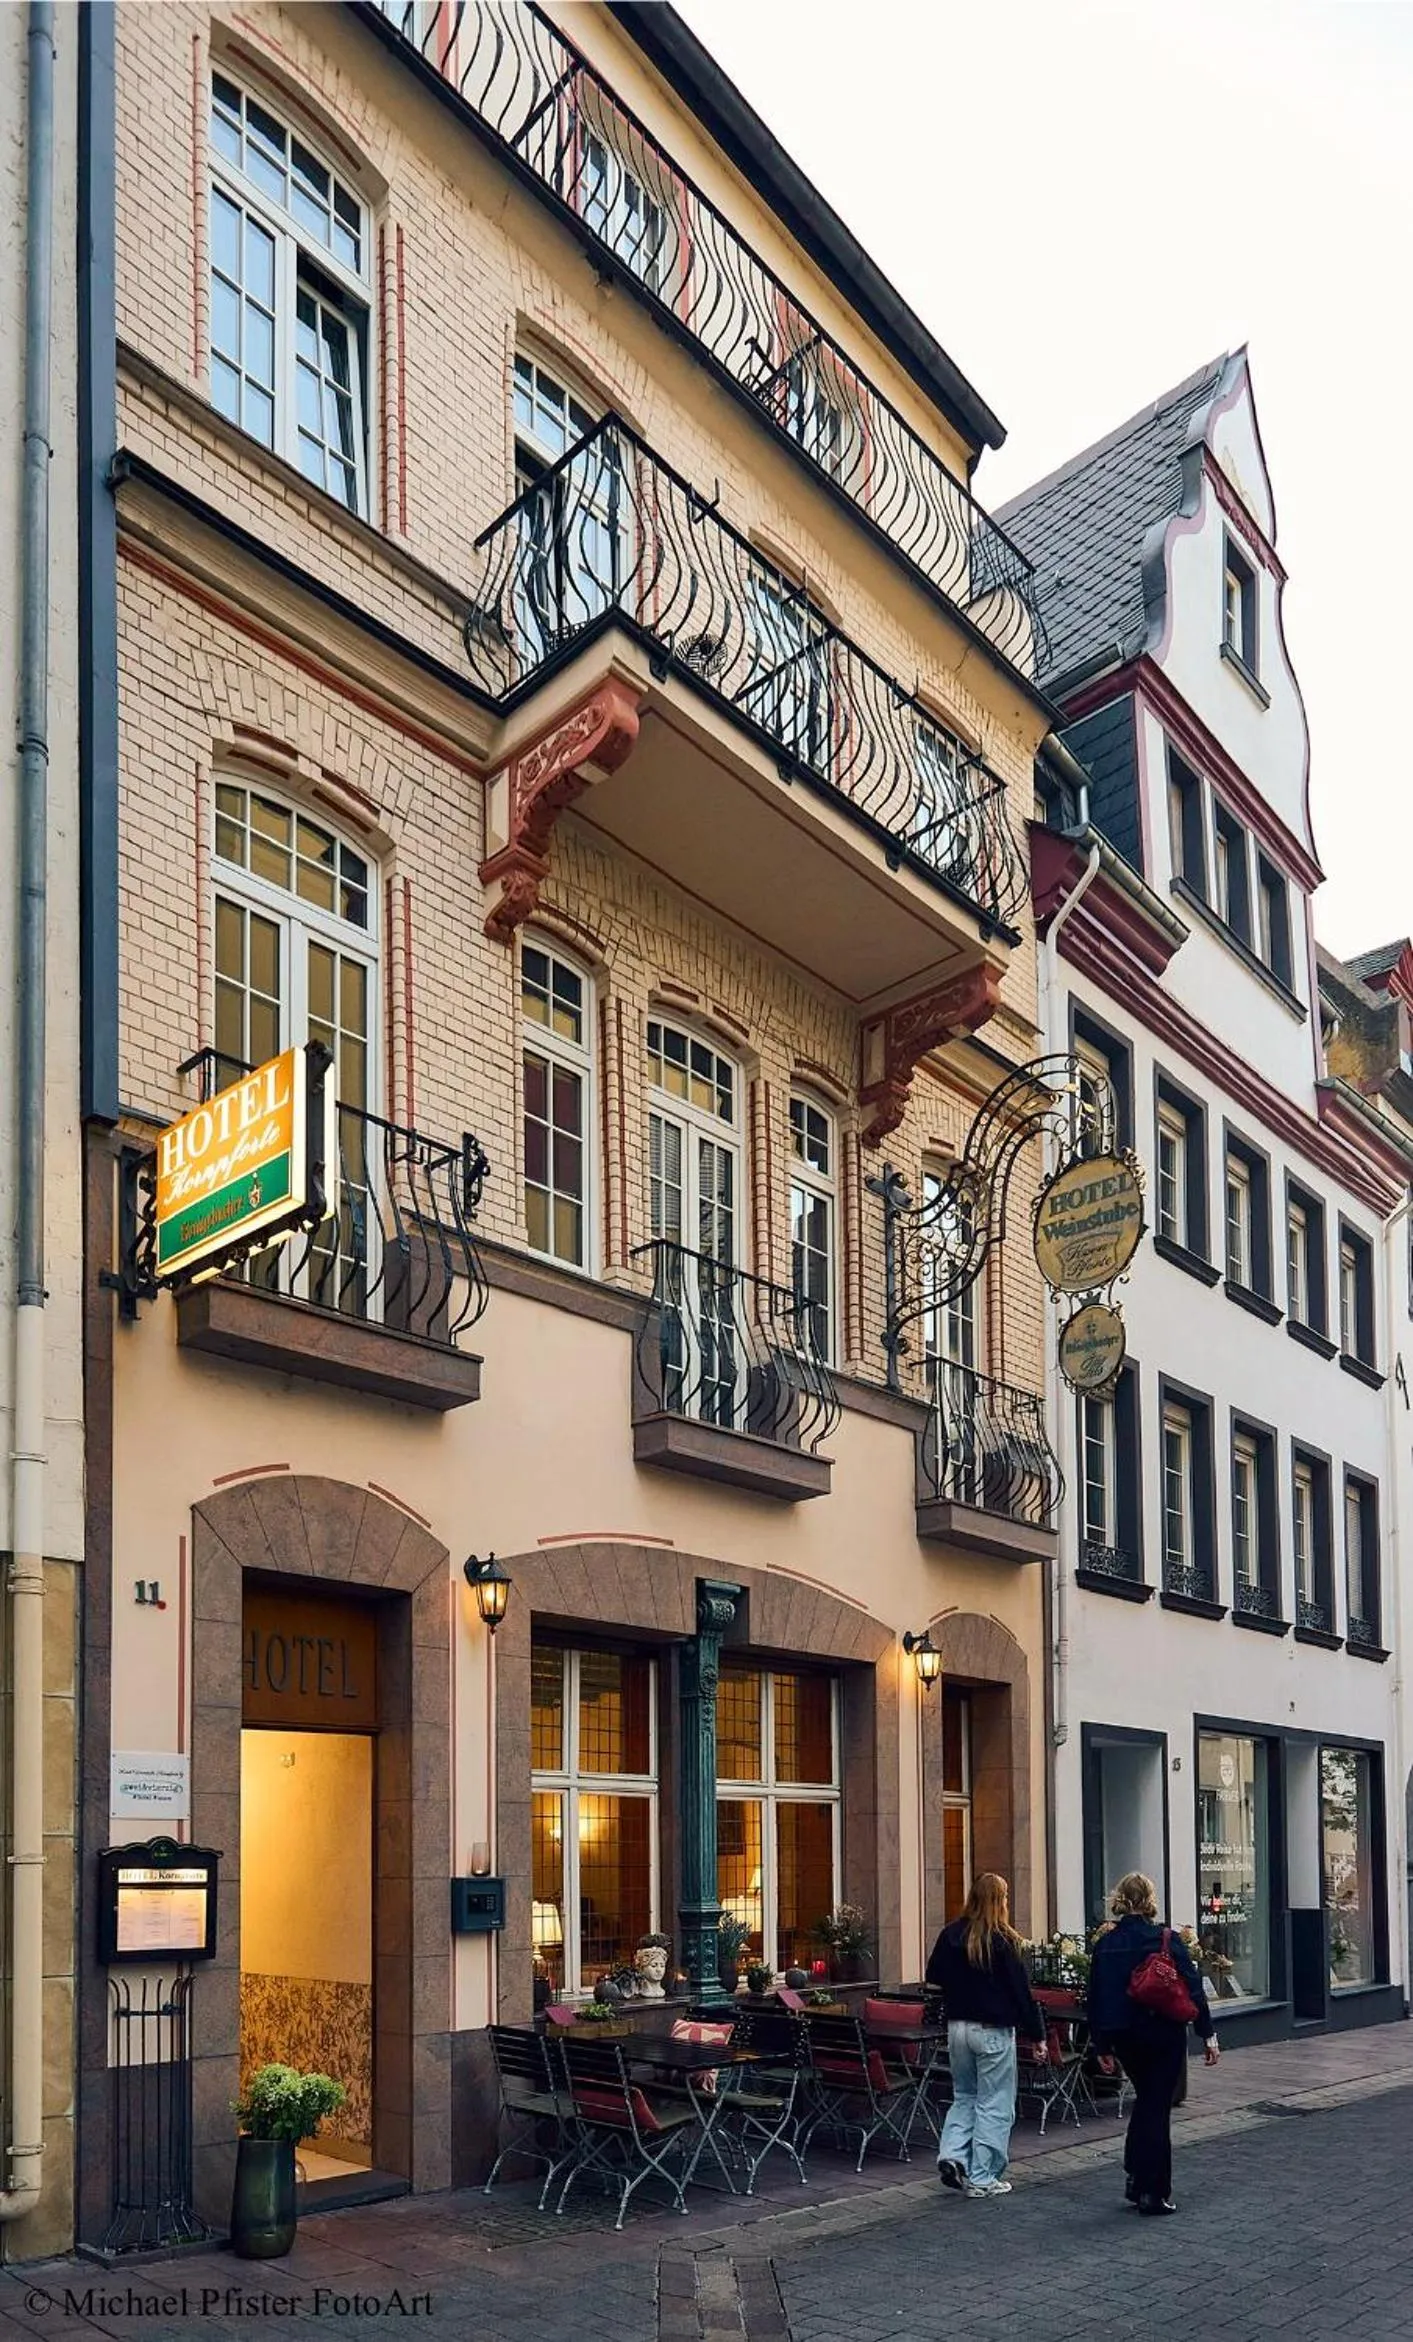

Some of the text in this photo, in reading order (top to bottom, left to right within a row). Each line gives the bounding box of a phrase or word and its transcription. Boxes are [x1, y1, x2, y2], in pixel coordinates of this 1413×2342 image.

[161, 1063, 290, 1178] HOTEL
[1048, 1171, 1134, 1218] HOTEL
[1040, 1201, 1139, 1243] Weinstube
[135, 1580, 160, 1605] 11
